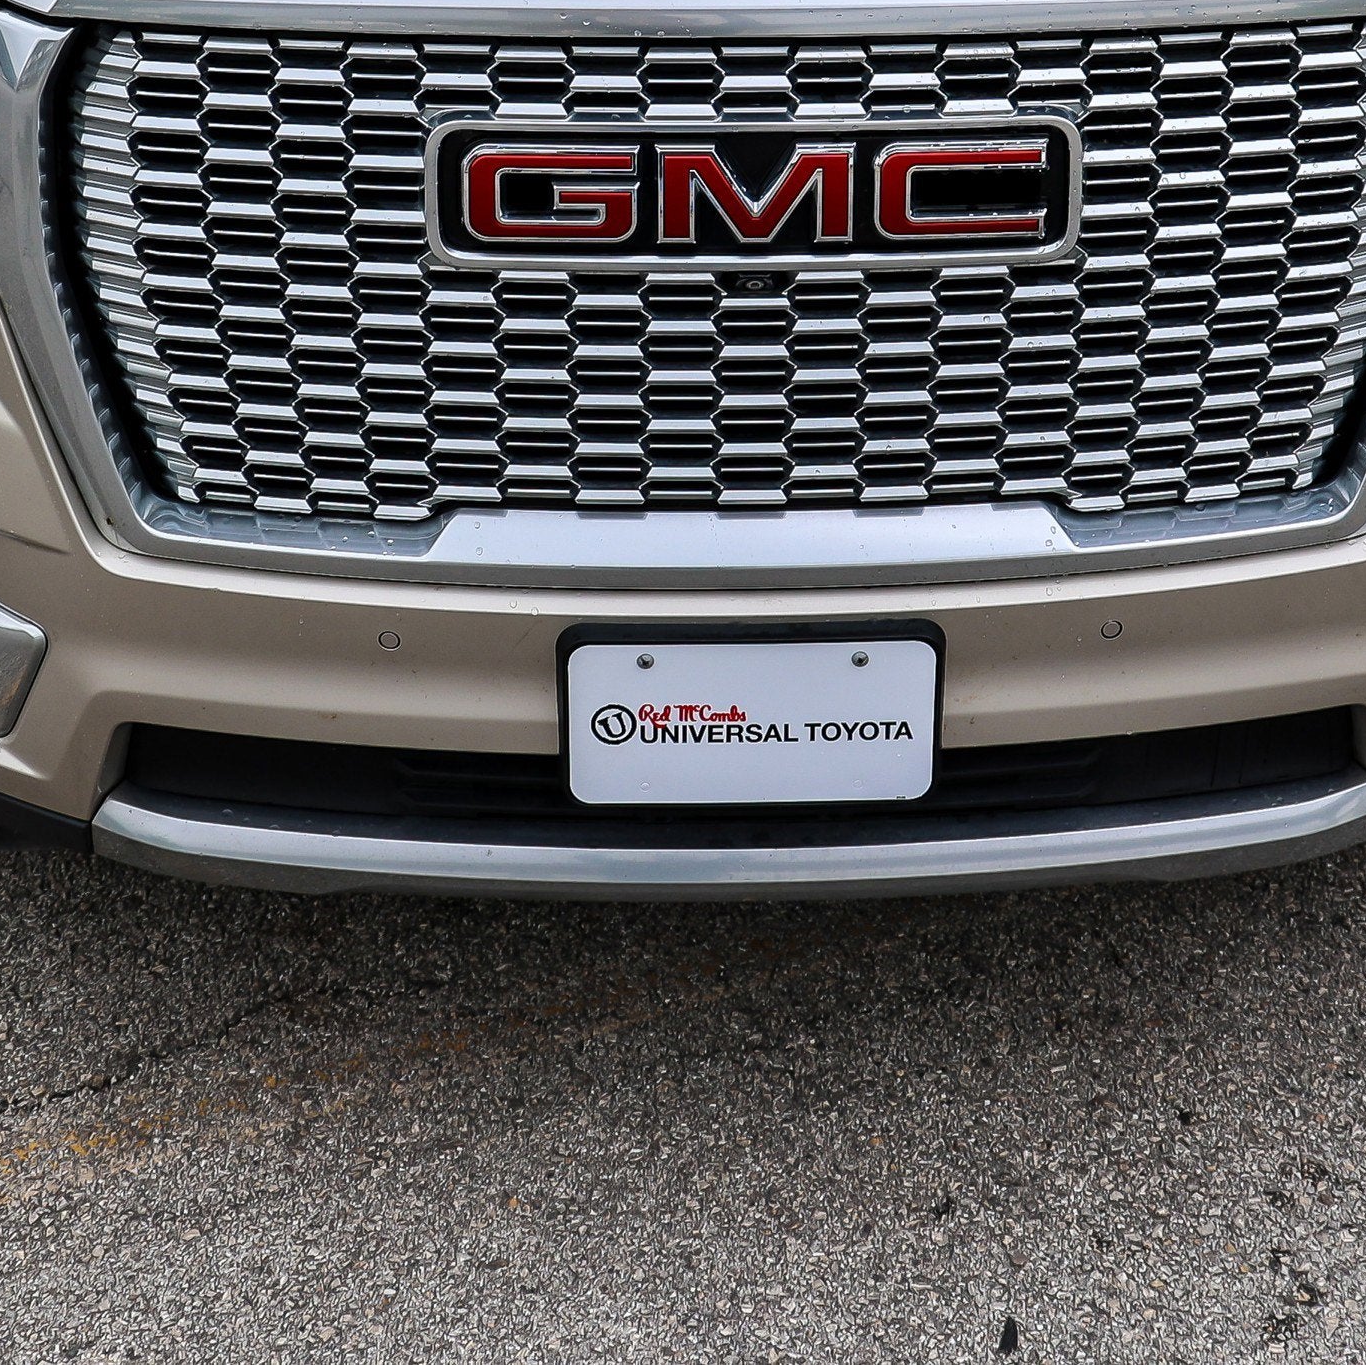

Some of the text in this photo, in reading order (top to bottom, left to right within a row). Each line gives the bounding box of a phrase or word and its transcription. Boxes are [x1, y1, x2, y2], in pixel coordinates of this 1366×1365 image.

[462, 142, 1047, 243] GMC
[638, 704, 747, 728] Red McCombs
[640, 721, 914, 744] UNIVERSAL TOYOTA
